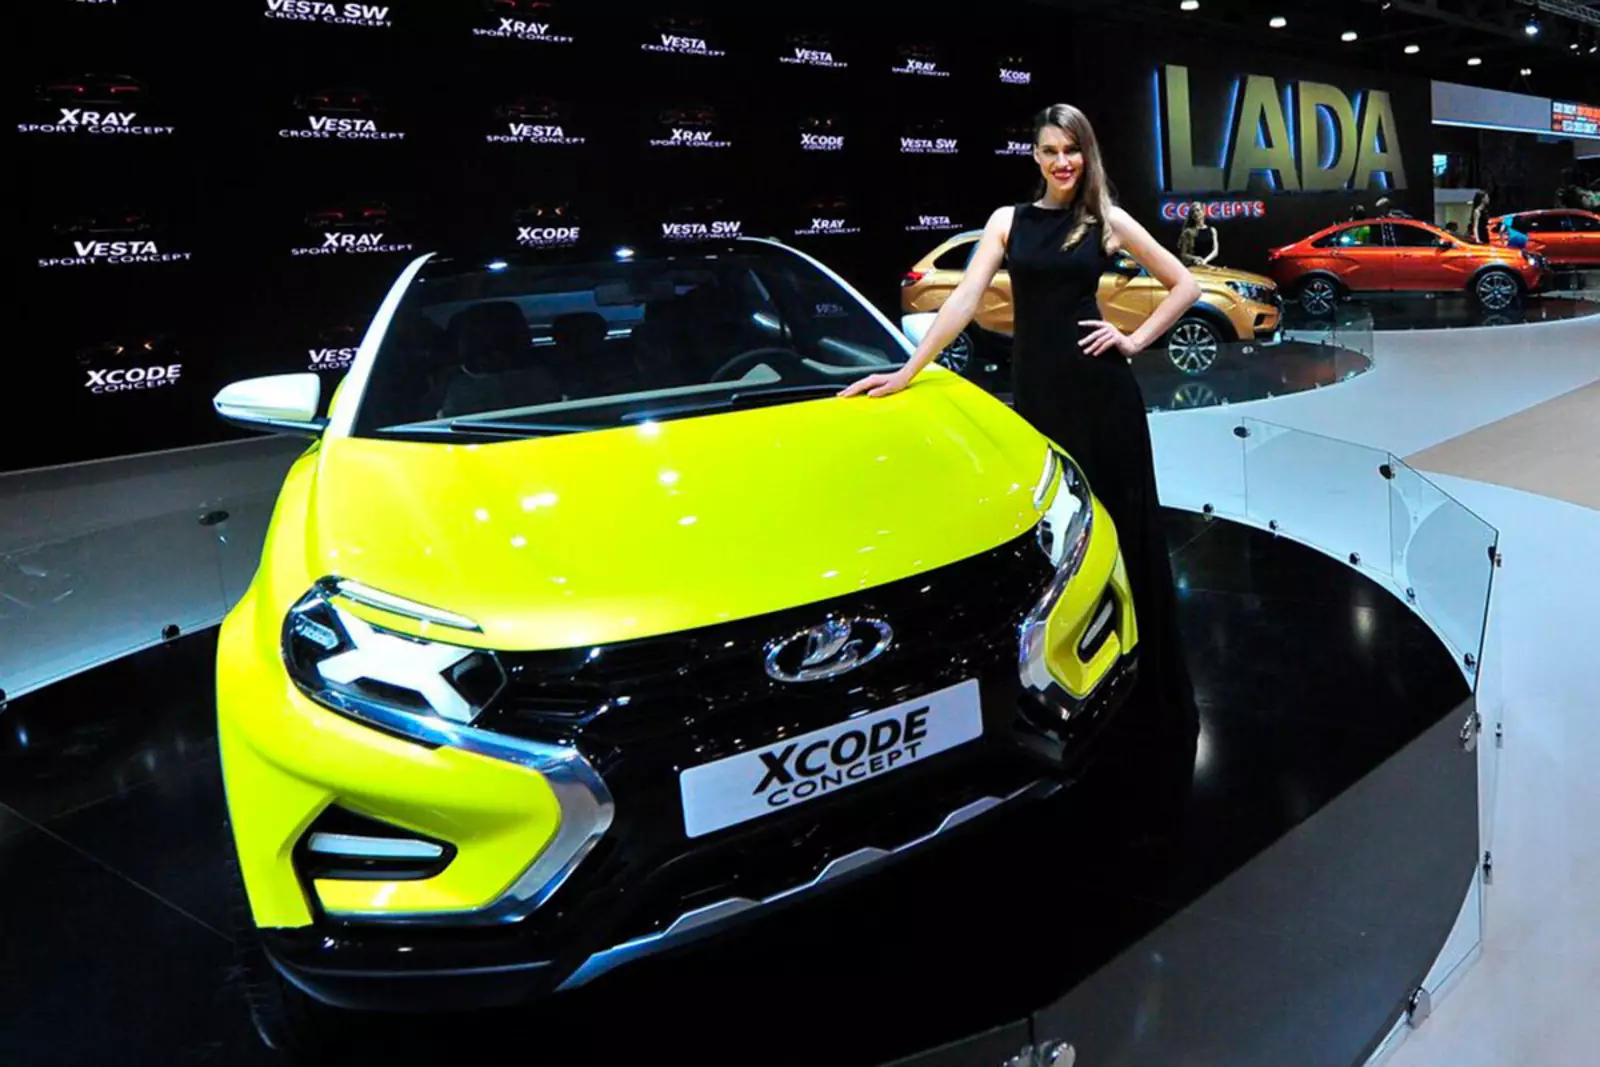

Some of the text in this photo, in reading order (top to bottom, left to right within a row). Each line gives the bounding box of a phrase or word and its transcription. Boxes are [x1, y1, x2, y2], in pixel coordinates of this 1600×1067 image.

[267, 0, 389, 20] VESTA SW
[264, 10, 392, 27] CROSS CONCEPT
[498, 17, 549, 34] XRAY
[661, 33, 706, 49] VESTA
[795, 47, 832, 61] VESTA
[906, 58, 936, 71] XRAY
[999, 68, 1031, 81] XCODE
[57, 108, 136, 126] XRAY
[308, 115, 377, 132] VESTA
[17, 123, 175, 135] SPORT CONCEPT
[278, 129, 406, 140] CROSS CONCEPT
[508, 122, 564, 138] VESTA
[671, 127, 713, 142] XRAY
[1157, 63, 1408, 193] LADA
[800, 132, 844, 147] XCODE
[900, 136, 957, 150] VESTA SW
[1161, 200, 1265, 220] COCEPTS
[662, 220, 741, 235] VESTA SW
[811, 217, 845, 230] XRAY
[919, 214, 951, 227] VESTA
[322, 232, 384, 249] XRAY
[516, 226, 580, 242] XCODE
[73, 240, 158, 257] VESTA
[291, 243, 413, 256] SPORT CONCEPT
[38, 252, 192, 267] SPORT CONCEPT
[308, 347, 358, 364] VES
[84, 363, 183, 388] XCODE
[91, 377, 176, 394] CONCEPT
[751, 705, 931, 796] XCODE
[766, 741, 923, 808] CONCEPT
